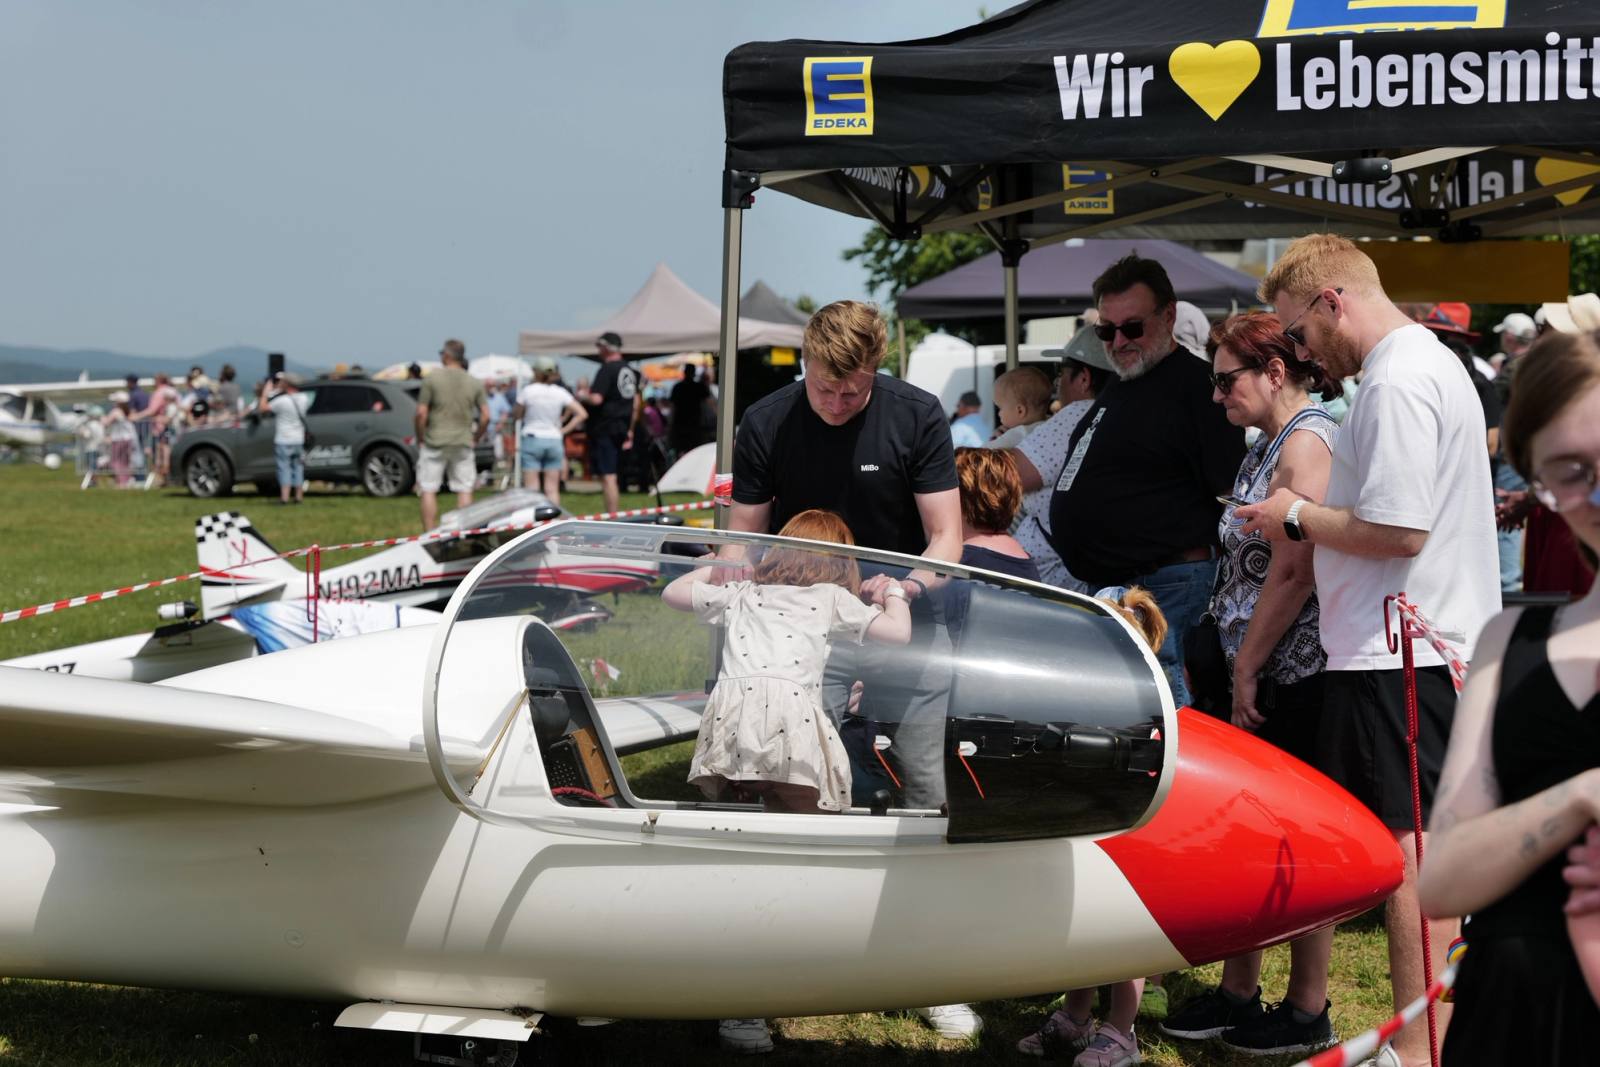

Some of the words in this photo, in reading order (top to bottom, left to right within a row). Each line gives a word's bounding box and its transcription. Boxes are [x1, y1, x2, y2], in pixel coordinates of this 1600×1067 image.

[1053, 52, 1154, 120] Wir
[813, 118, 868, 129] EDEKA
[860, 464, 880, 472] MiBo
[317, 564, 421, 600] N192MA
